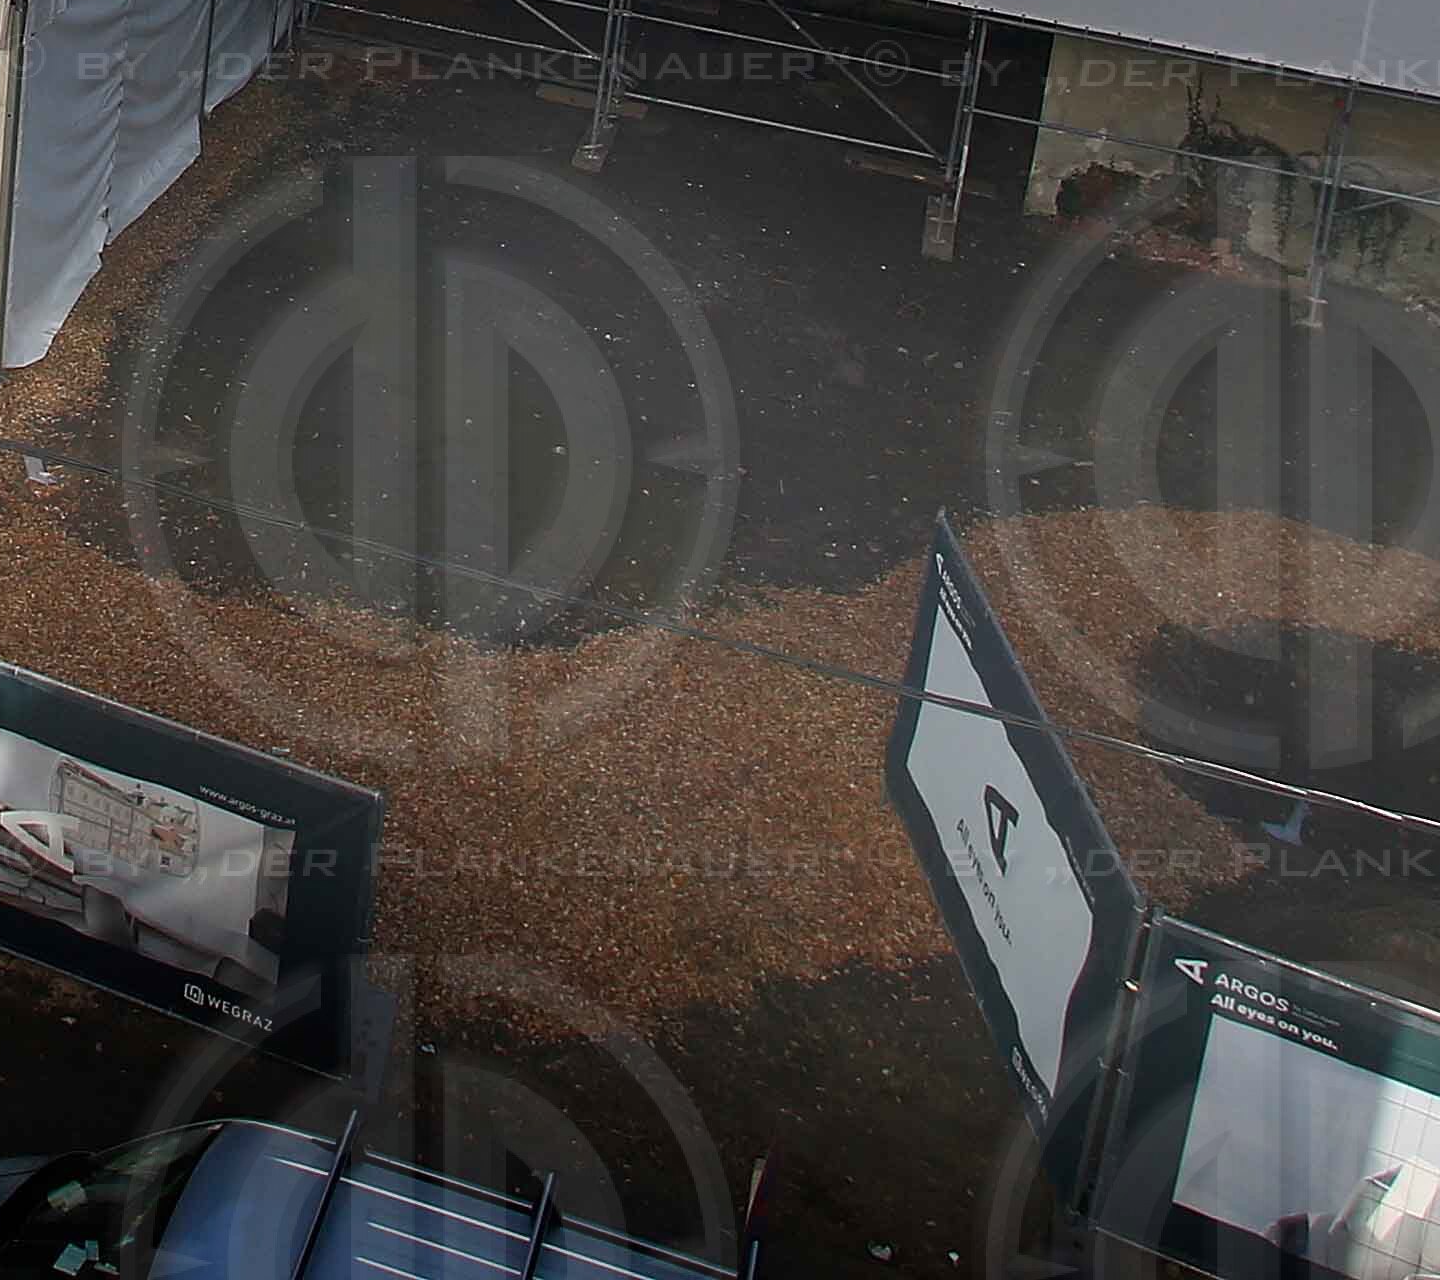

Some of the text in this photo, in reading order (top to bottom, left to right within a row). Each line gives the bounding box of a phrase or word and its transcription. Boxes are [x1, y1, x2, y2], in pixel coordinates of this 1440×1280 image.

[207, 993, 273, 1033] WEGRAZ
[1214, 972, 1291, 1013] ARGOS
[1211, 993, 1236, 1011] All
[1236, 1002, 1275, 1025] eyes
[1278, 1016, 1300, 1035] on
[1300, 1025, 1339, 1051] you.
